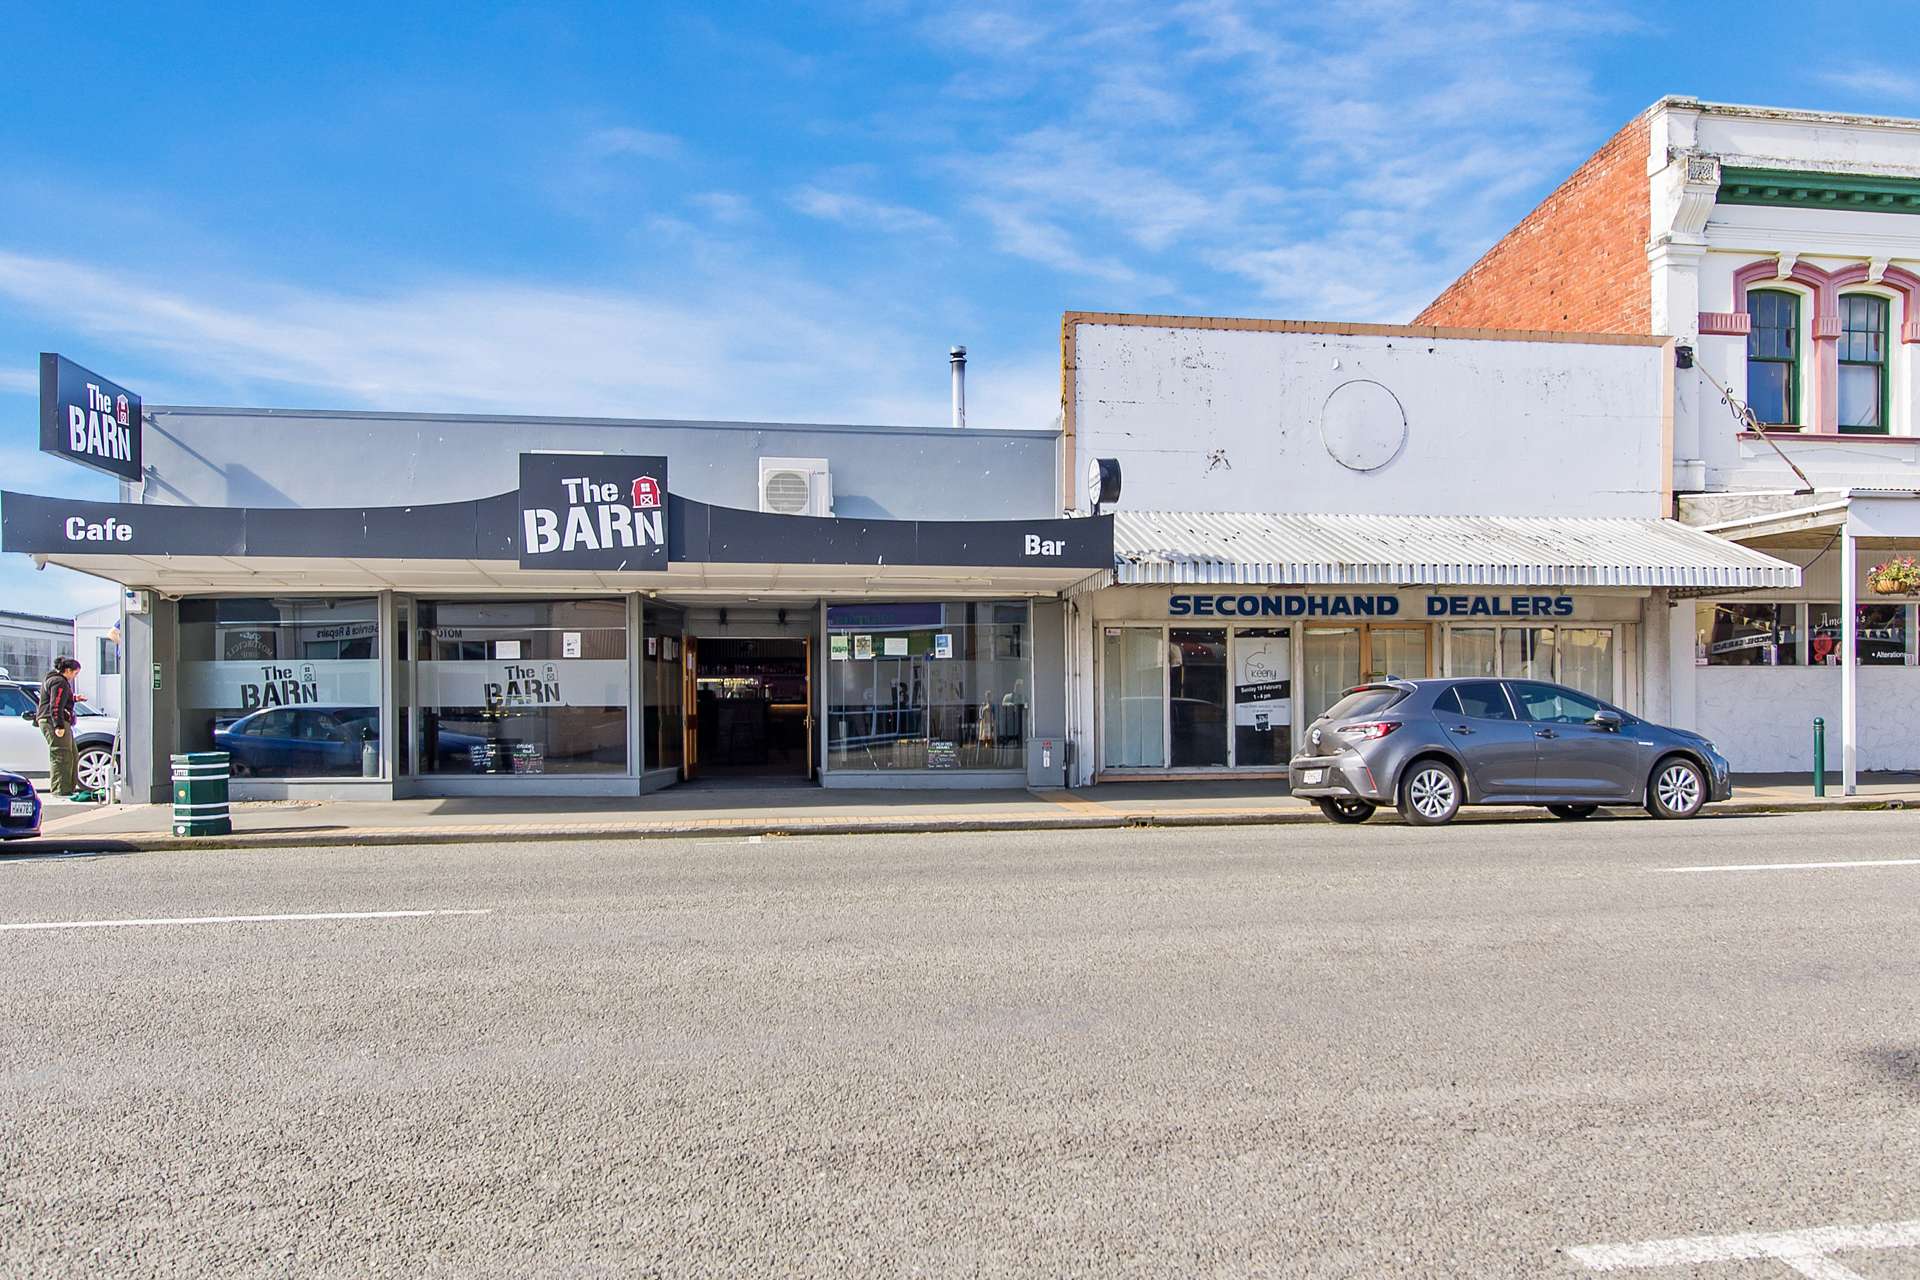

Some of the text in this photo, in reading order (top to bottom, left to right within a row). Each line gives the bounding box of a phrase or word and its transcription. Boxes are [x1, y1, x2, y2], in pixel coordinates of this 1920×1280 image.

[86, 382, 112, 414] The
[68, 404, 132, 461] BARN
[562, 477, 619, 504] The
[65, 516, 133, 542] Cafe
[523, 504, 664, 554] BARN
[1024, 534, 1066, 556] Bar
[1169, 595, 1574, 616] SECONDHAND DEALERS
[261, 666, 292, 681] The
[504, 665, 535, 680] The
[240, 680, 318, 708] BARN
[484, 679, 561, 708] BARN
